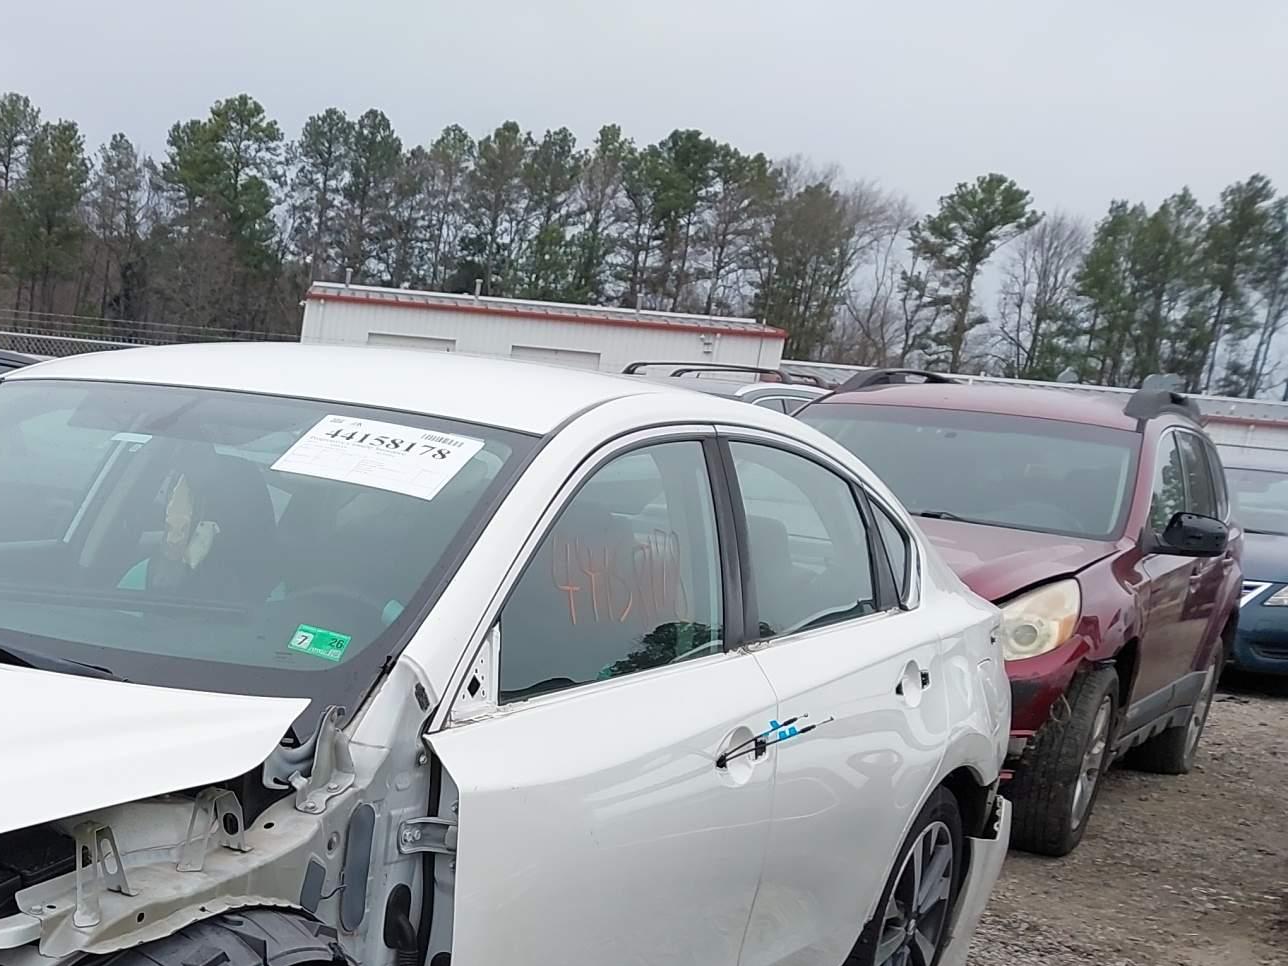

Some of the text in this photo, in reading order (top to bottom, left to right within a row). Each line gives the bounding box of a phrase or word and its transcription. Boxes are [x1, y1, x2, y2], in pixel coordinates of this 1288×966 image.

[325, 428, 451, 460] 44158178
[298, 635, 344, 649] 7 26
